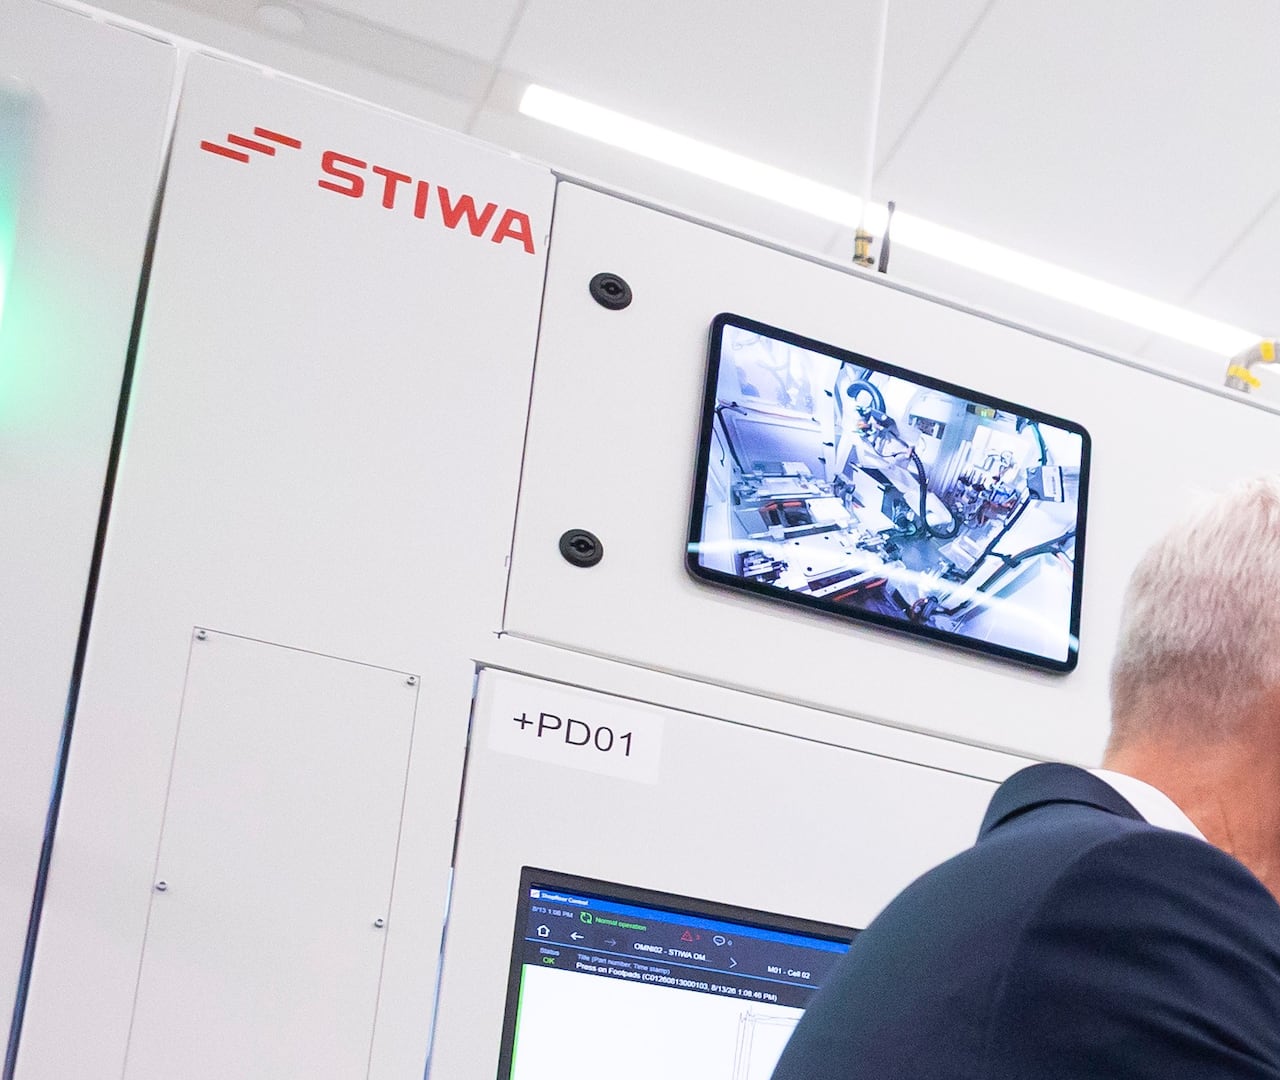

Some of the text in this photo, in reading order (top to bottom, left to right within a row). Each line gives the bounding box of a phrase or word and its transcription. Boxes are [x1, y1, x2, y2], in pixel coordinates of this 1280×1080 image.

[318, 150, 536, 255] STIWA
[513, 711, 633, 757] +PD01
[595, 916, 647, 932] Normal operation
[542, 956, 556, 965] OK
[668, 948, 692, 959] STIWA
[576, 961, 597, 972] Press
[597, 966, 608, 974] on
[608, 967, 641, 979] Footpads
